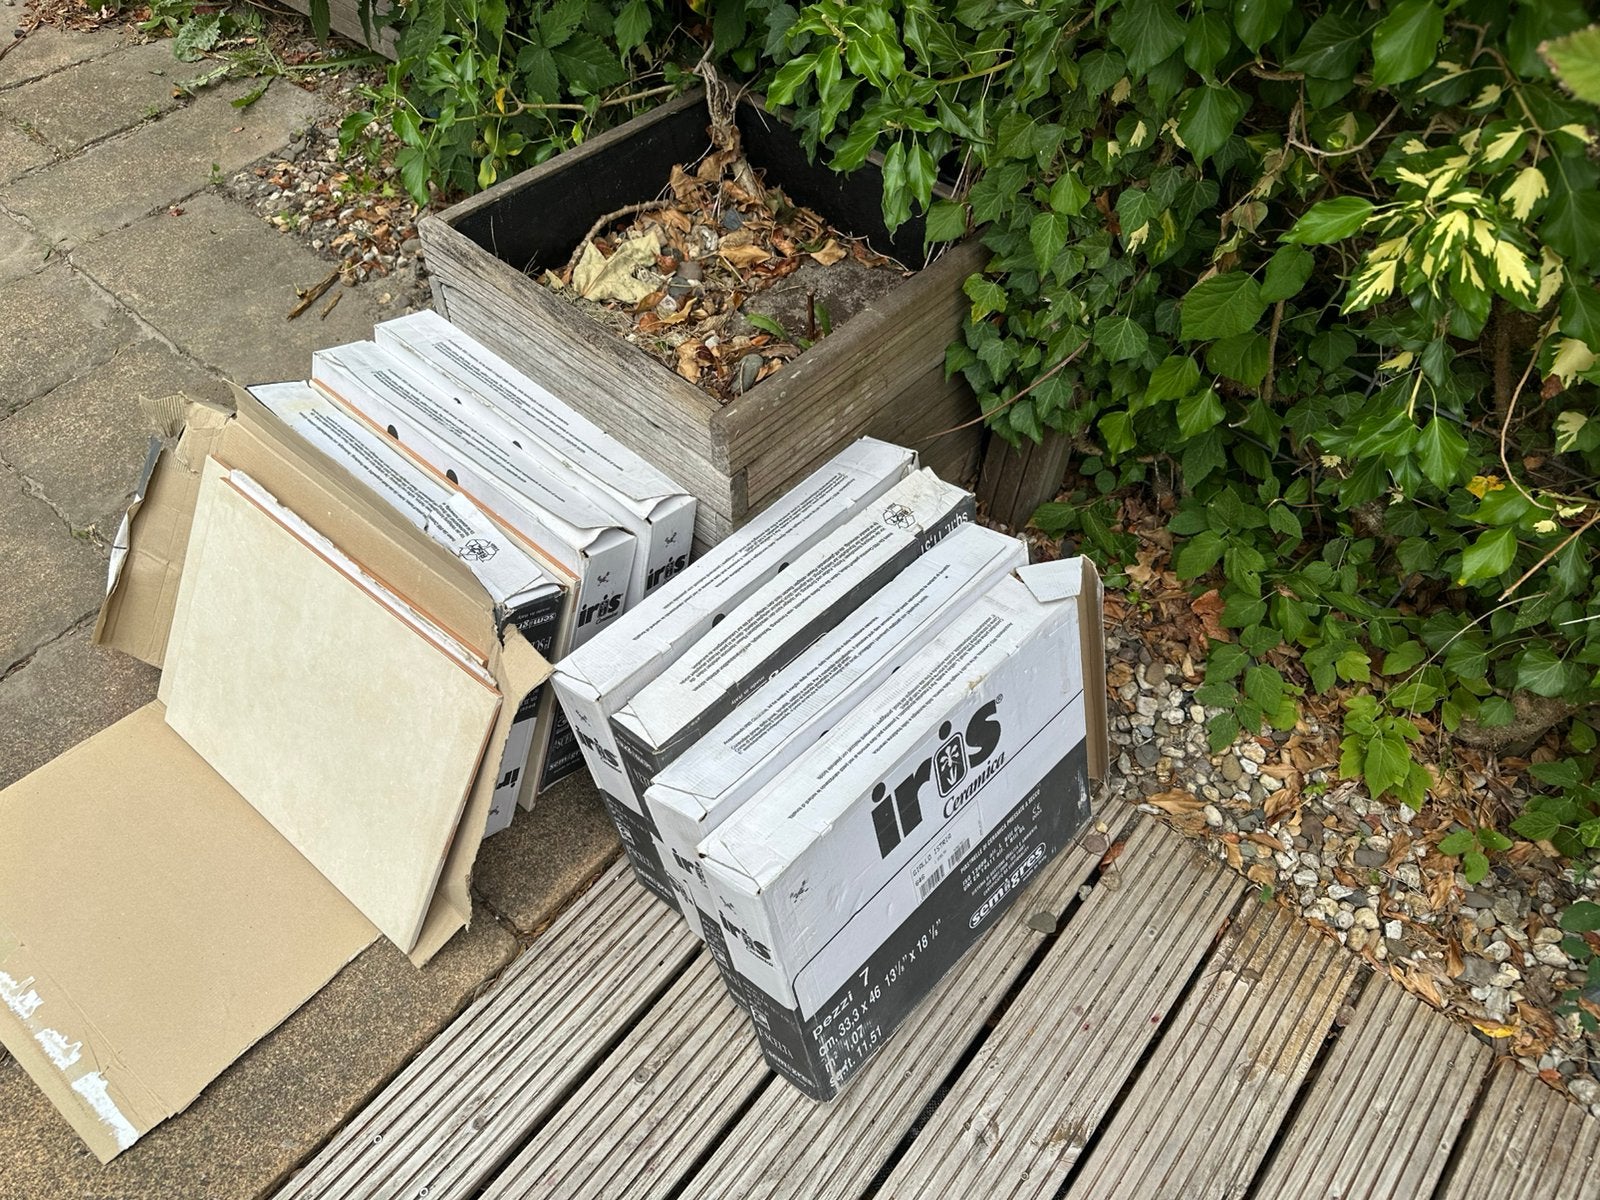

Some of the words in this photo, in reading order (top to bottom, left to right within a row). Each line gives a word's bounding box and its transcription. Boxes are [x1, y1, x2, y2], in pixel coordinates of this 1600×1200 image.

[646, 554, 688, 591] iris
[578, 593, 624, 628] iris
[575, 725, 619, 767] iris
[496, 767, 520, 789] ir
[871, 698, 1002, 859] iris
[943, 752, 1004, 818] Ceramica
[912, 854, 931, 876] GIALLO
[972, 844, 1041, 927] semigres
[718, 909, 772, 960] iris
[813, 991, 852, 1039] pezzi
[859, 966, 868, 986] 7
[838, 1008, 859, 1036] 33,3
[861, 1001, 867, 1013] x
[869, 985, 880, 1002] 46
[909, 949, 915, 962] x
[916, 934, 927, 952] 18
[857, 1025, 881, 1056] 11,51
